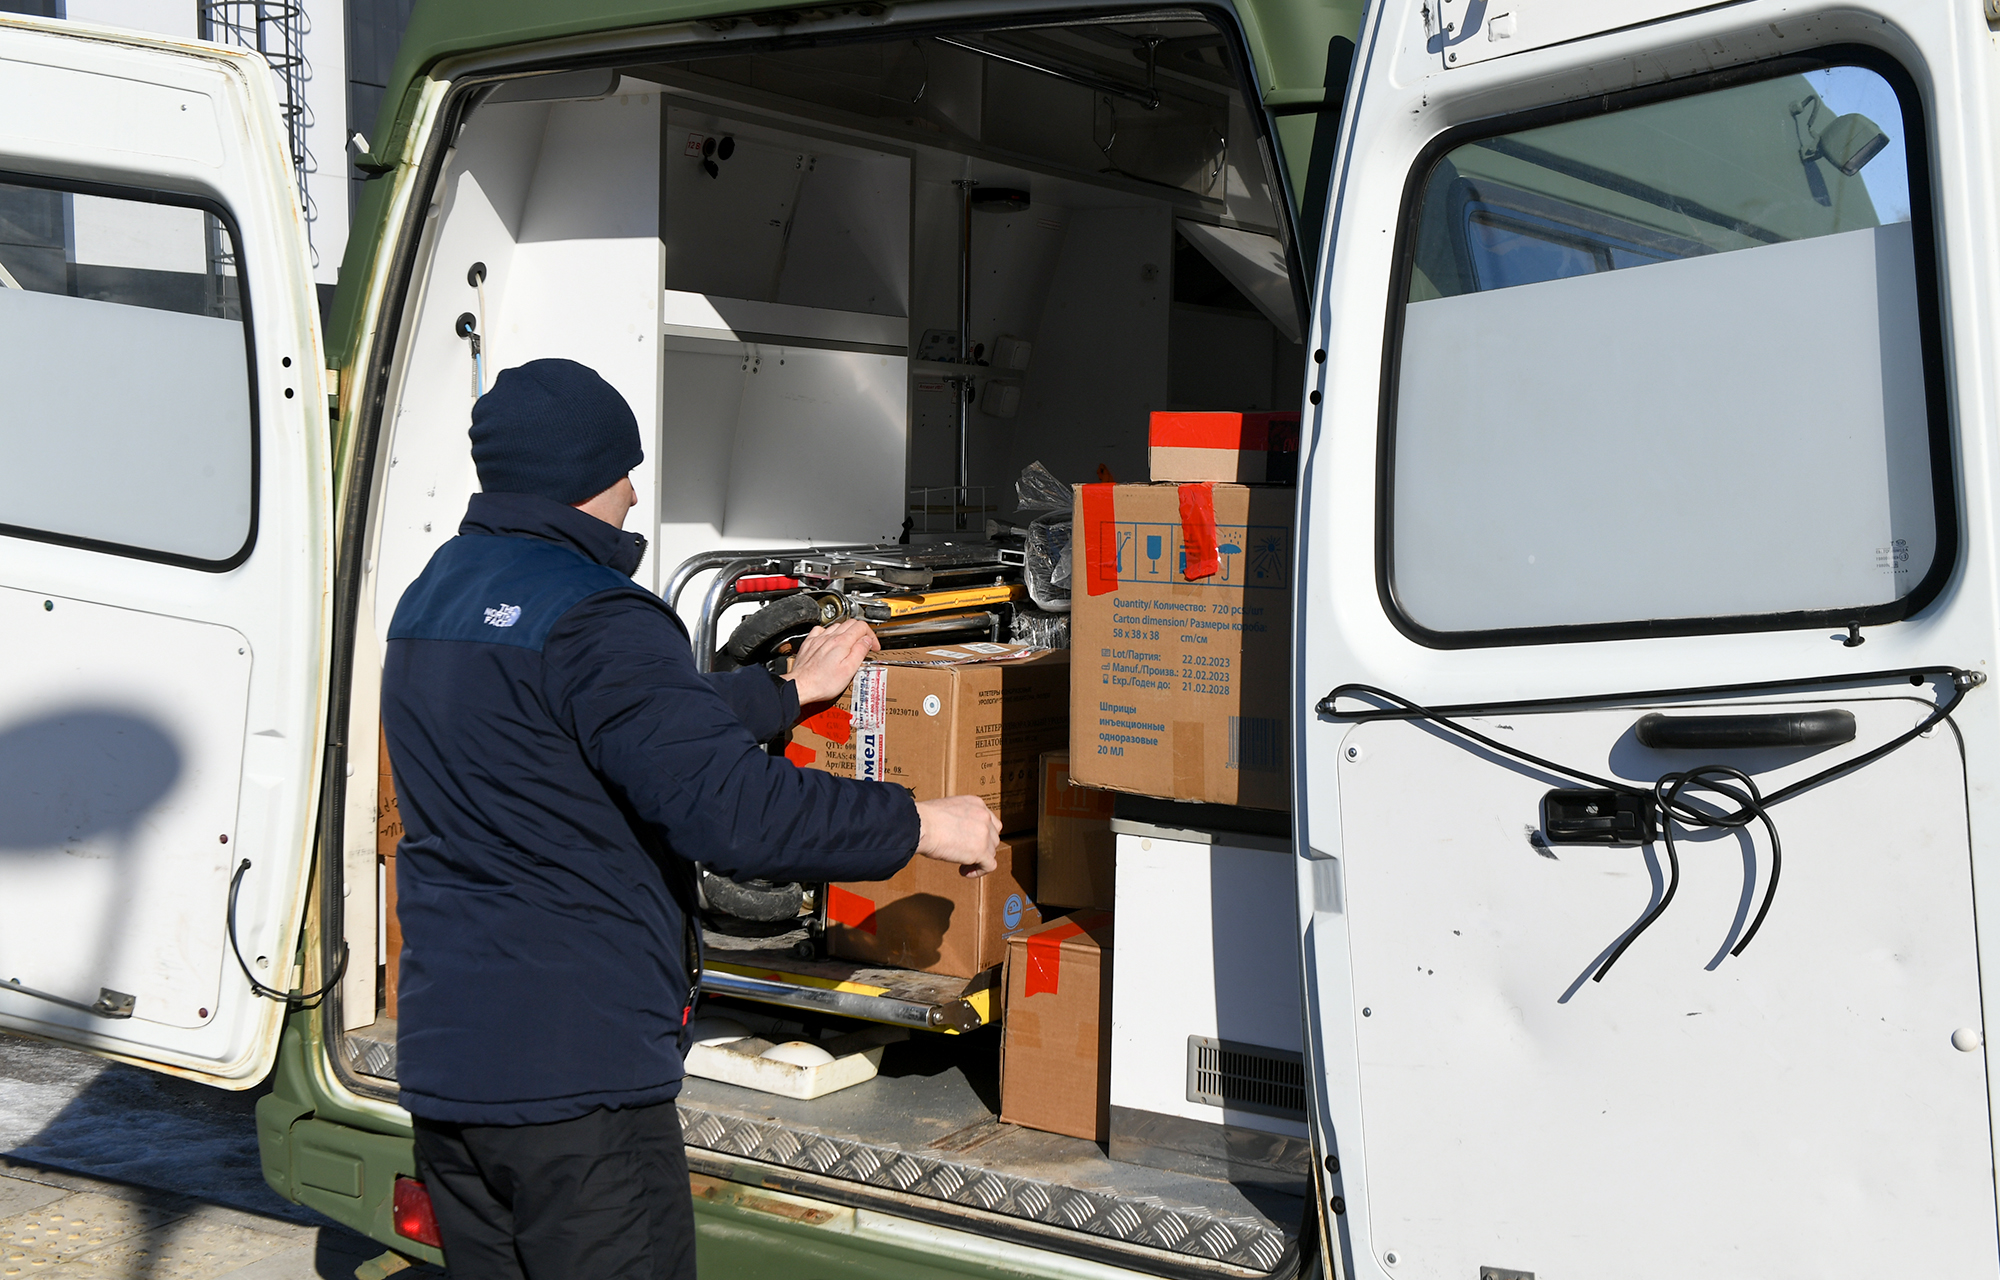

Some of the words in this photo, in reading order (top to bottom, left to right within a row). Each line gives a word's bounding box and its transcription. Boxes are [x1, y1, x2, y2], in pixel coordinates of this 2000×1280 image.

[1113, 597, 1152, 611] Quantity/
[1153, 600, 1207, 612] Количество:
[1212, 604, 1229, 615] 720
[484, 616, 509, 627] FACE
[1113, 613, 1140, 624] Carton
[1142, 615, 1188, 627] dimension/
[1190, 618, 1230, 631] Размеры
[1232, 621, 1267, 633] короба:
[1113, 628, 1123, 638] 58
[1131, 629, 1141, 640] 38
[1142, 632, 1148, 640] x
[1149, 630, 1160, 641] 38
[1180, 633, 1208, 644] cm/см
[1112, 649, 1161, 662] Lot/Партия:
[1112, 662, 1179, 677] Manuf./Произв.:
[1112, 675, 1156, 688] Exp./Годен
[1157, 681, 1171, 690] до:
[978, 689, 1000, 697] КАТЕТЕРЫ
[889, 708, 919, 717] 20230710
[1099, 701, 1137, 715] Шприцы
[1099, 718, 1165, 732] инъекционные
[825, 741, 842, 749] QTY:
[1099, 733, 1158, 746] одноразовые
[825, 751, 848, 760] MEAS:
[1097, 745, 1108, 755] 20
[1110, 746, 1124, 756] МЛ
[825, 760, 856, 770] Арт/REF:
[893, 766, 902, 774] 08
